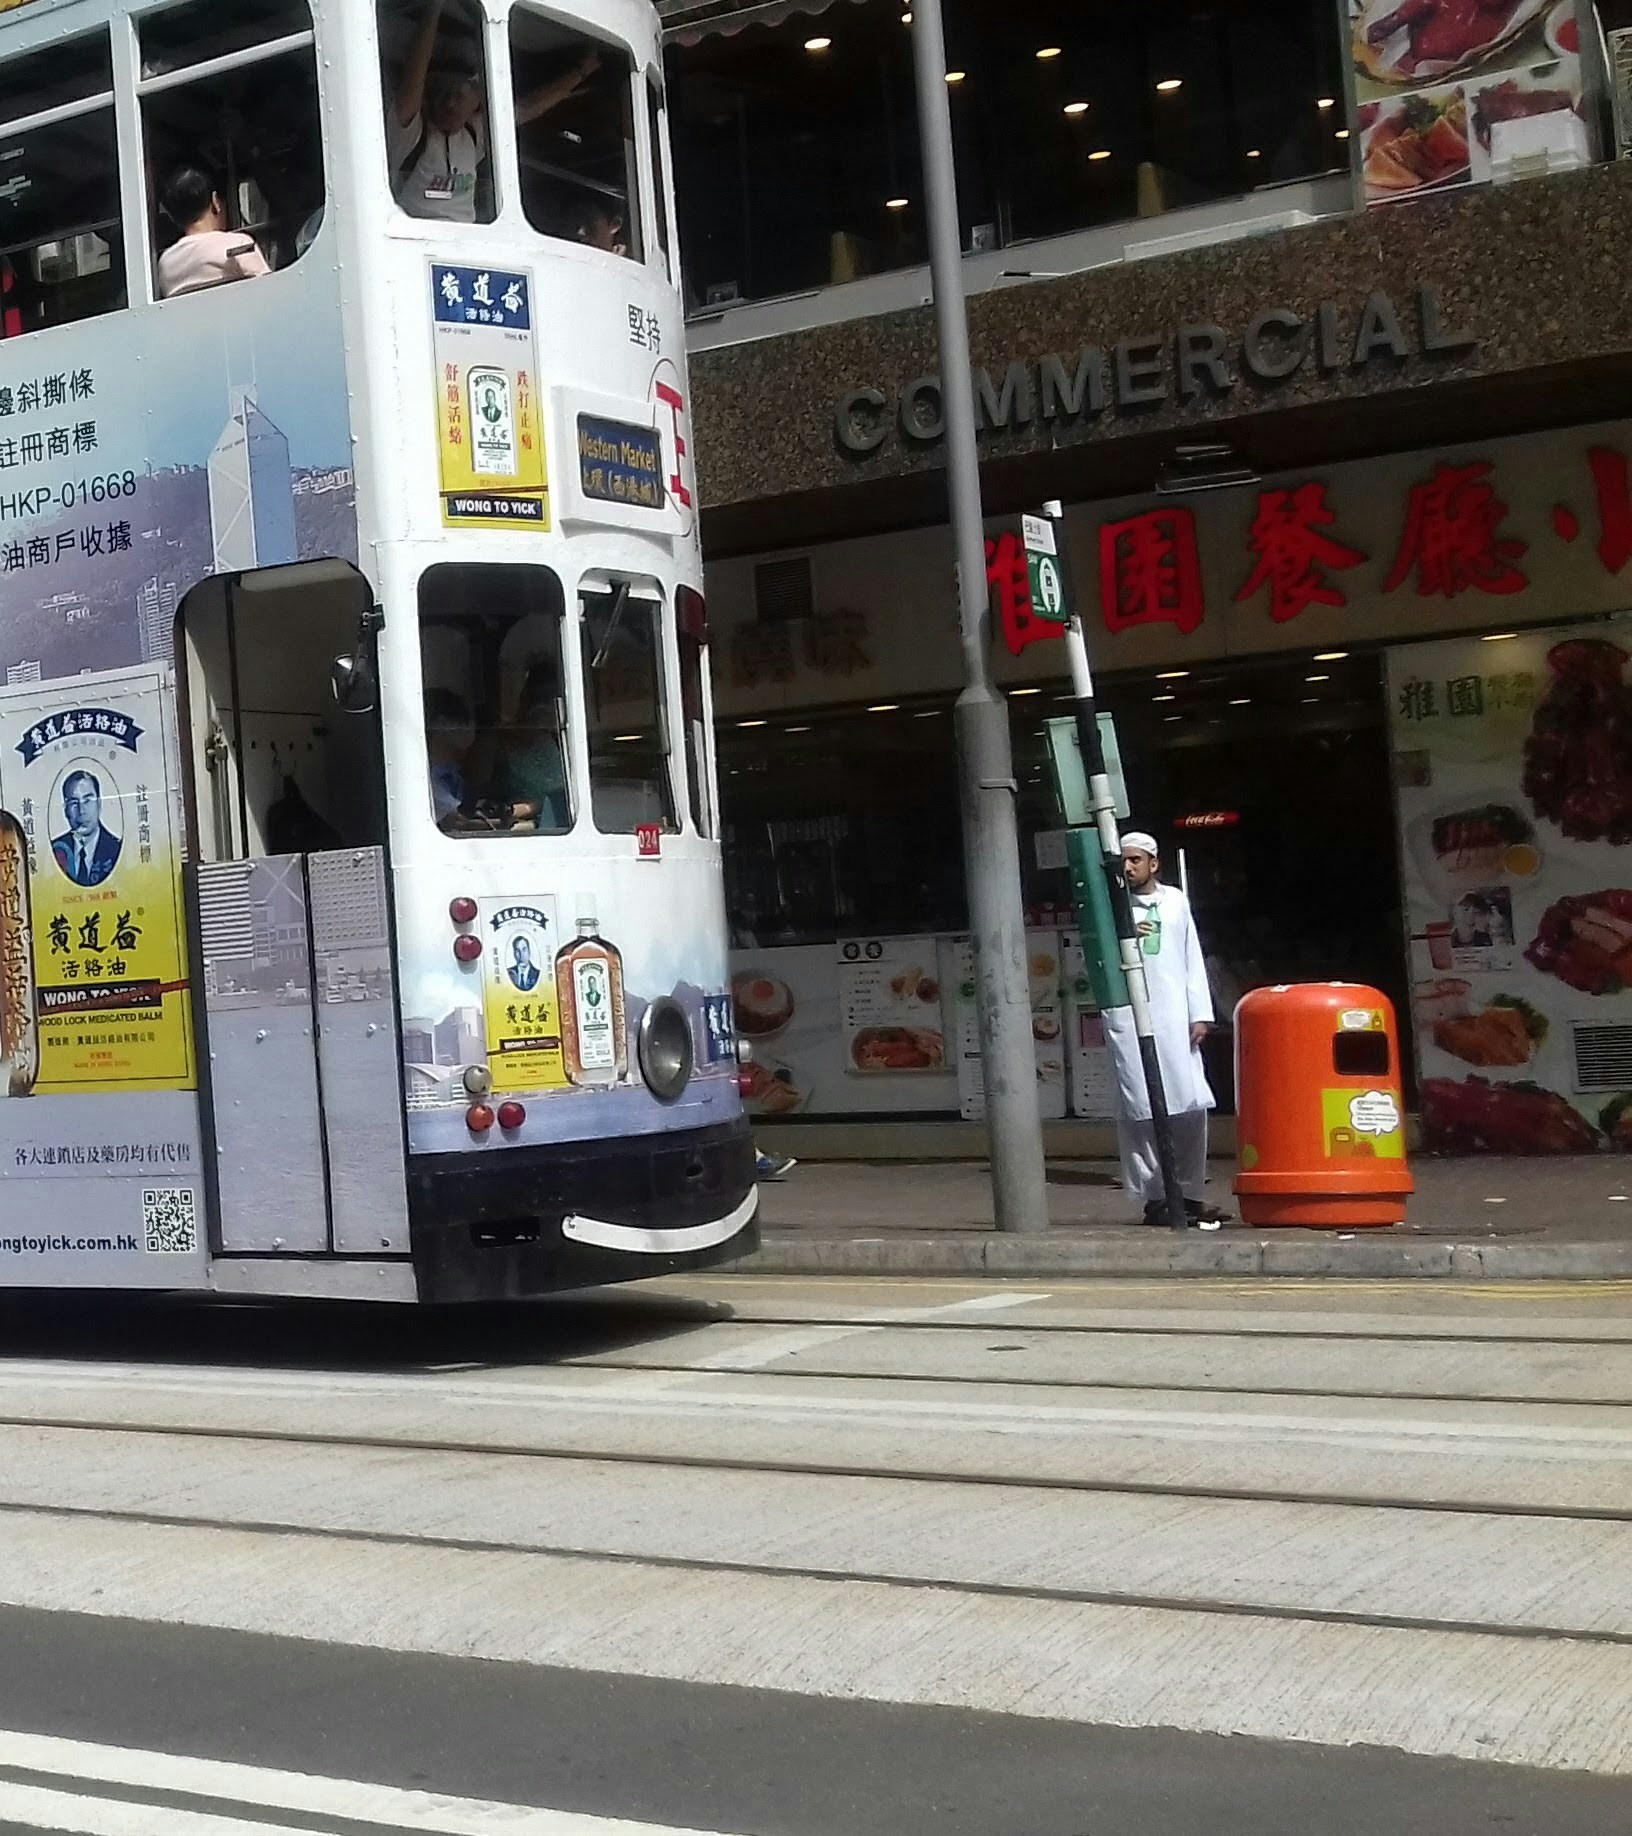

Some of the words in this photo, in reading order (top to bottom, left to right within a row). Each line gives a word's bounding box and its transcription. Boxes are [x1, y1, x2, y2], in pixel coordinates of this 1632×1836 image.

[627, 304, 662, 355] 堅持
[835, 288, 1478, 453] COMMERCIAL
[578, 430, 619, 463] Western
[621, 440, 657, 474] Market
[455, 499, 492, 513] WONG
[493, 500, 509, 514] TO
[511, 501, 536, 515] YICK
